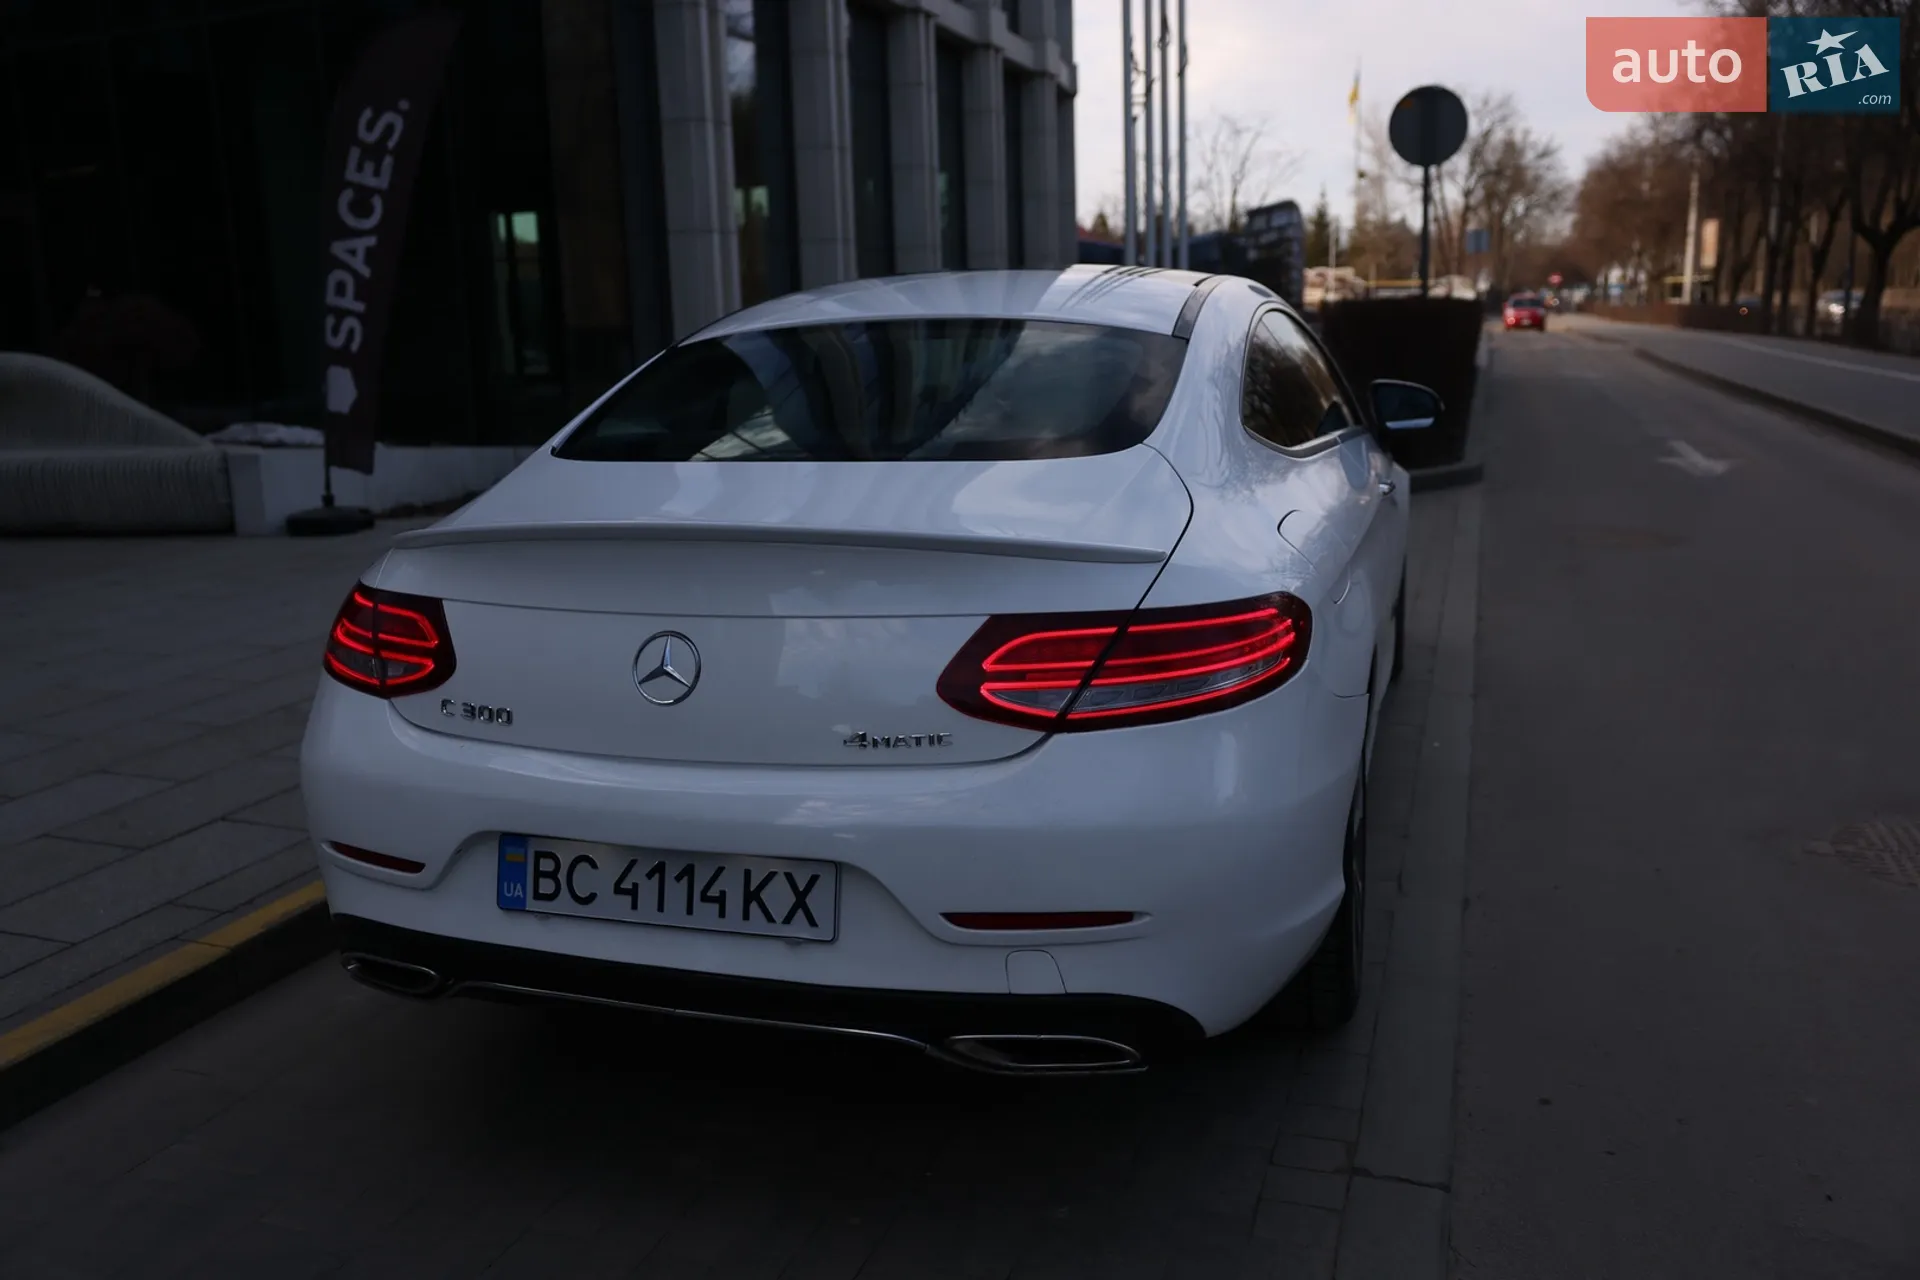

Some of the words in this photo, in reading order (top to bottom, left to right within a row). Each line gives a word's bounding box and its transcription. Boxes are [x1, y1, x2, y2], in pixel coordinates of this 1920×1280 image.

[324, 98, 410, 354] SPACES.
[441, 698, 456, 717] C
[460, 702, 513, 726] 300
[843, 731, 954, 749] 4MATIC
[503, 882, 524, 899] UA
[533, 851, 599, 905] BC
[613, 859, 727, 918] 4114
[743, 869, 821, 927] KX
